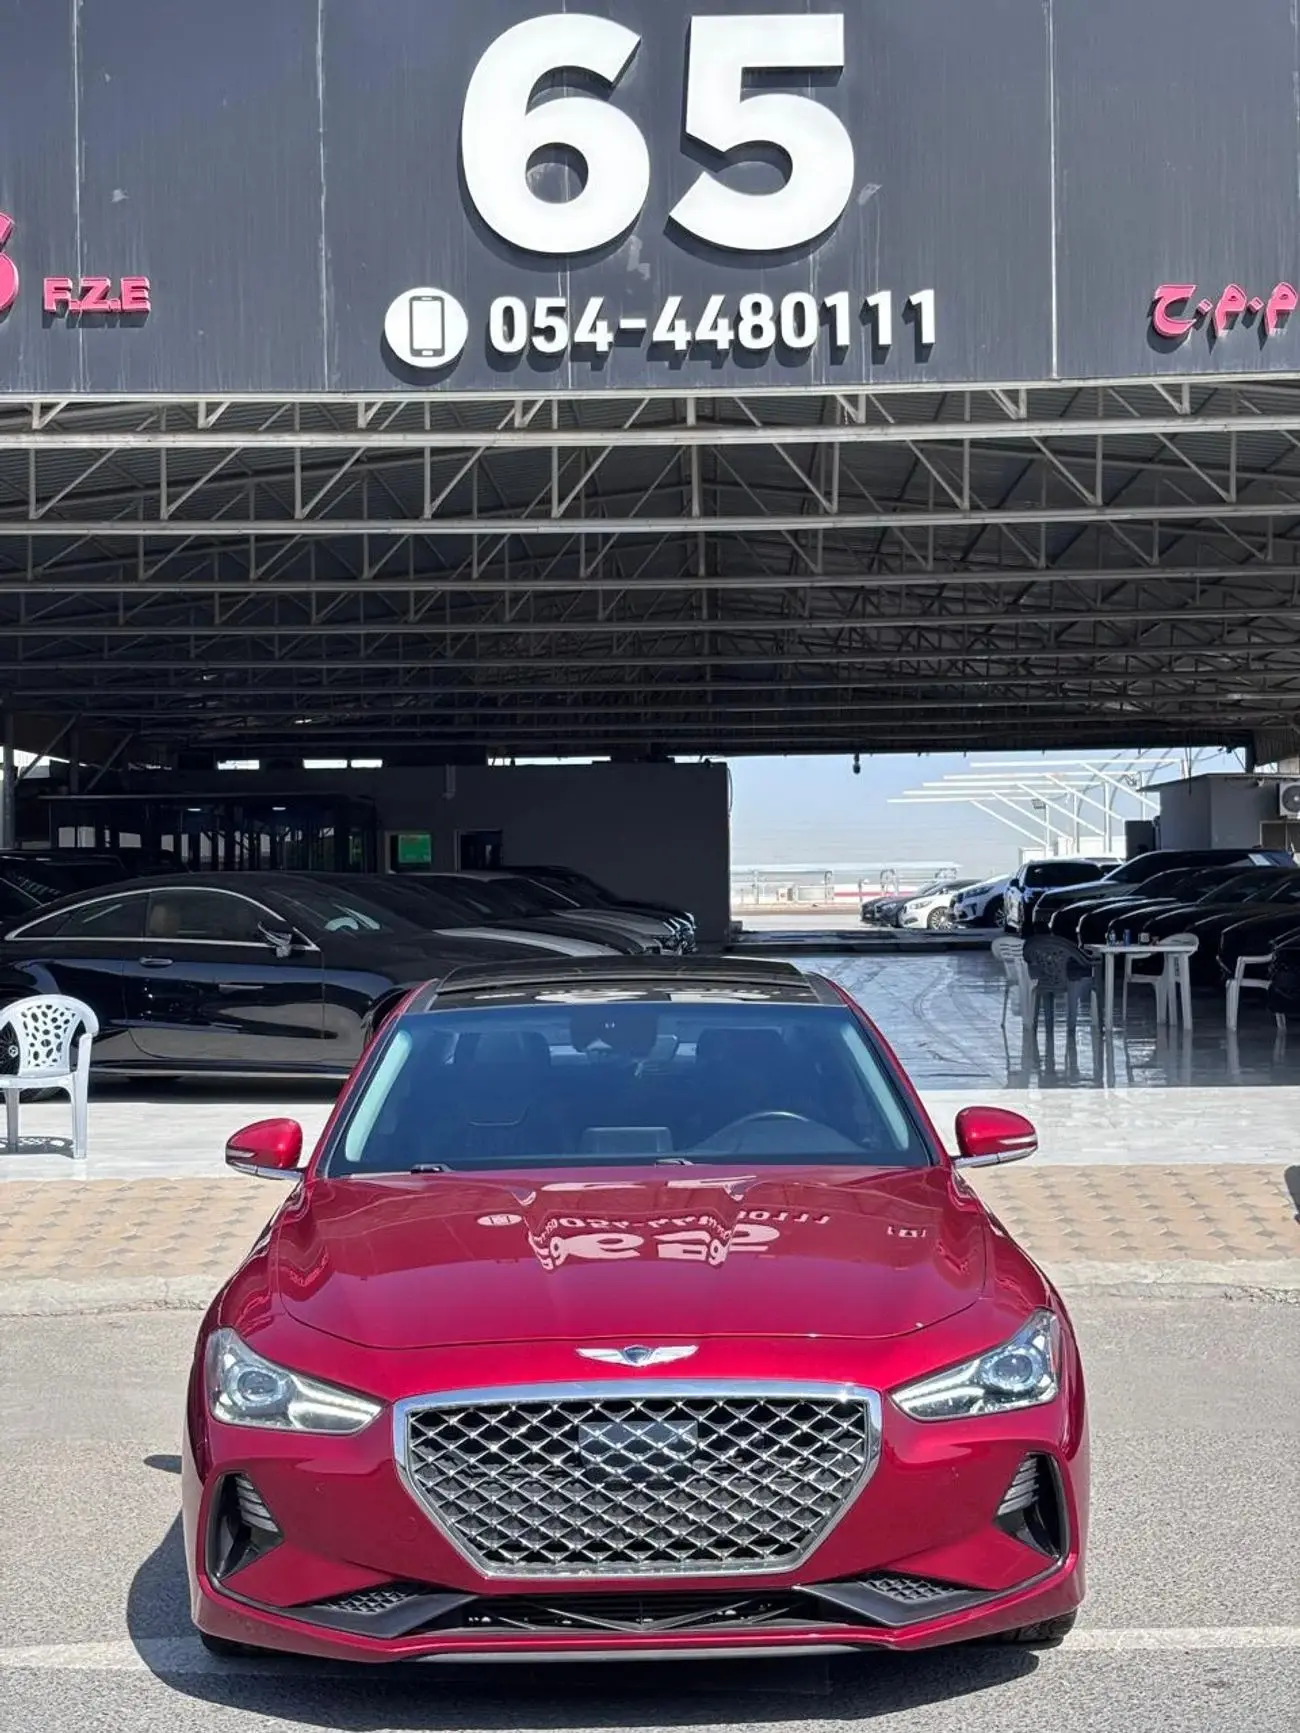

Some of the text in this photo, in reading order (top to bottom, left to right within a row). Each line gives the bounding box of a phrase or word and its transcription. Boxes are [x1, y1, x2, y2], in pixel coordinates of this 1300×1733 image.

[461, 12, 855, 254] 65
[43, 276, 151, 313] F.Z.E
[488, 288, 936, 354] 054-4480111
